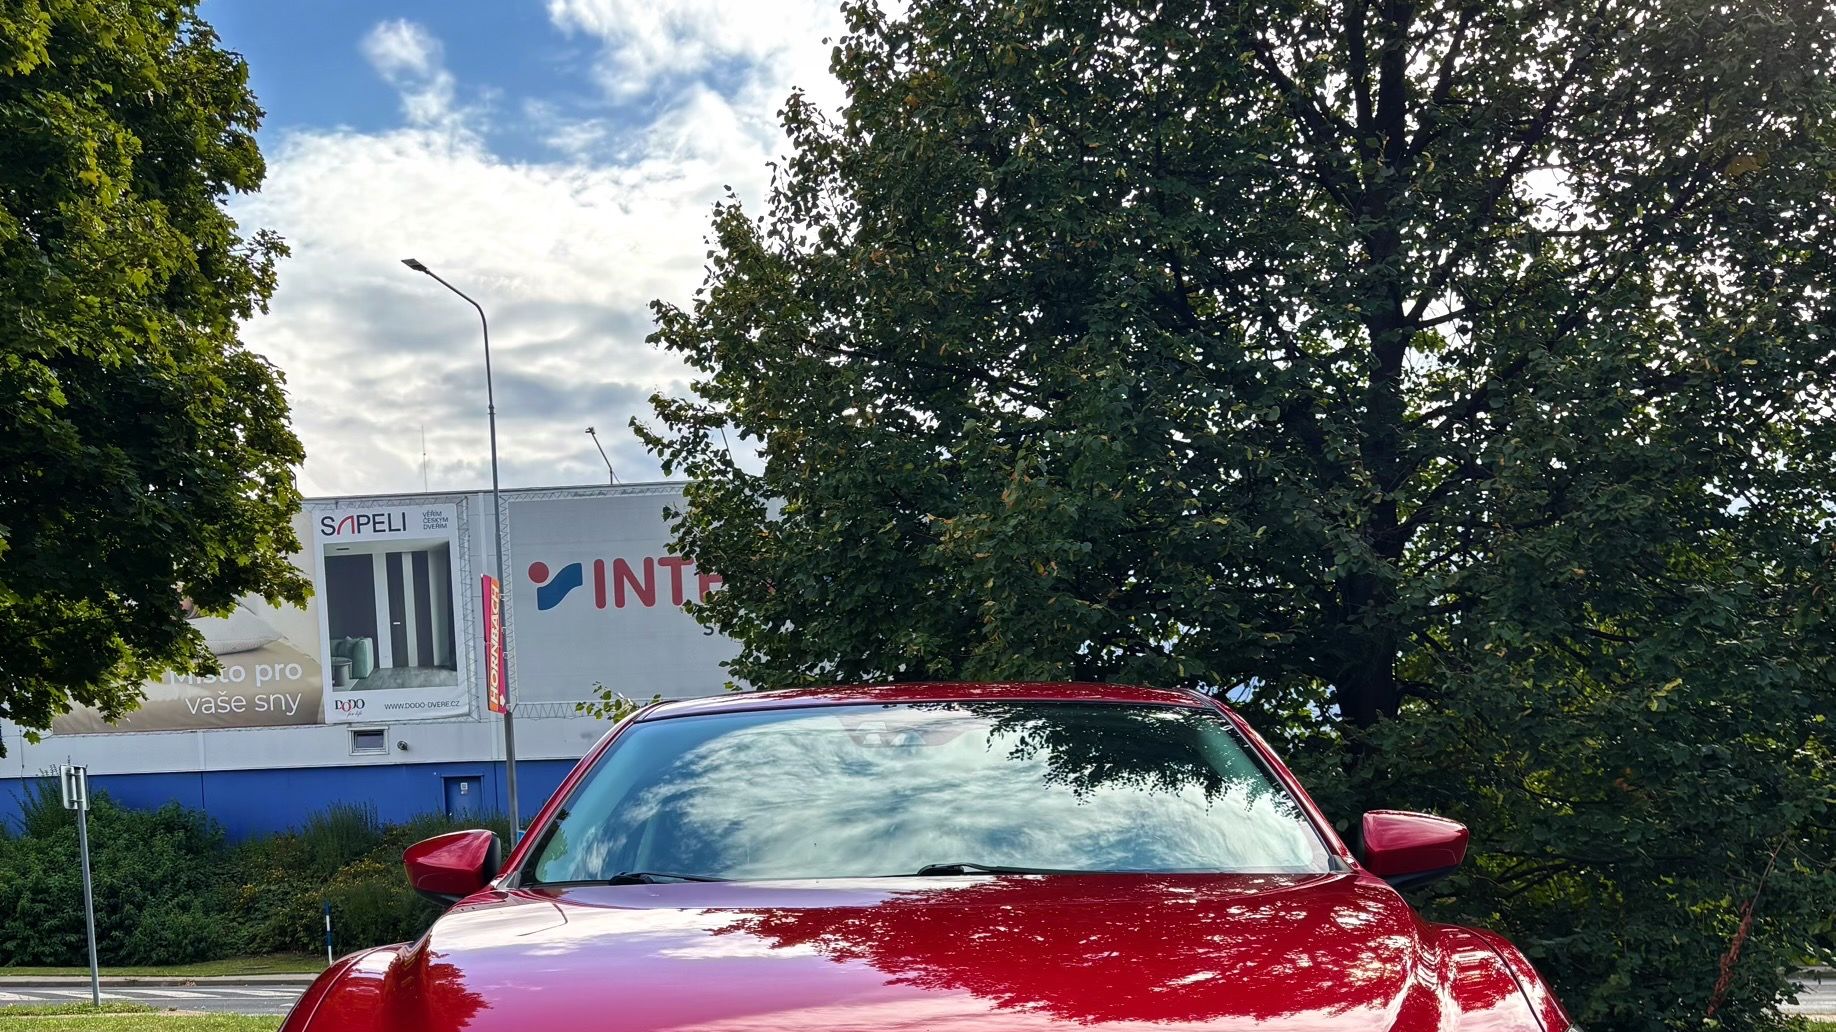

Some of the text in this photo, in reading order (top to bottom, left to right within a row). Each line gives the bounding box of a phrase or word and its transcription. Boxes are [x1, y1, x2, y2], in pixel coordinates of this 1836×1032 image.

[488, 585, 500, 705] HORNBACH
[255, 662, 303, 688] pro
[185, 690, 302, 716] vaše sny
[335, 698, 365, 712] DODO
